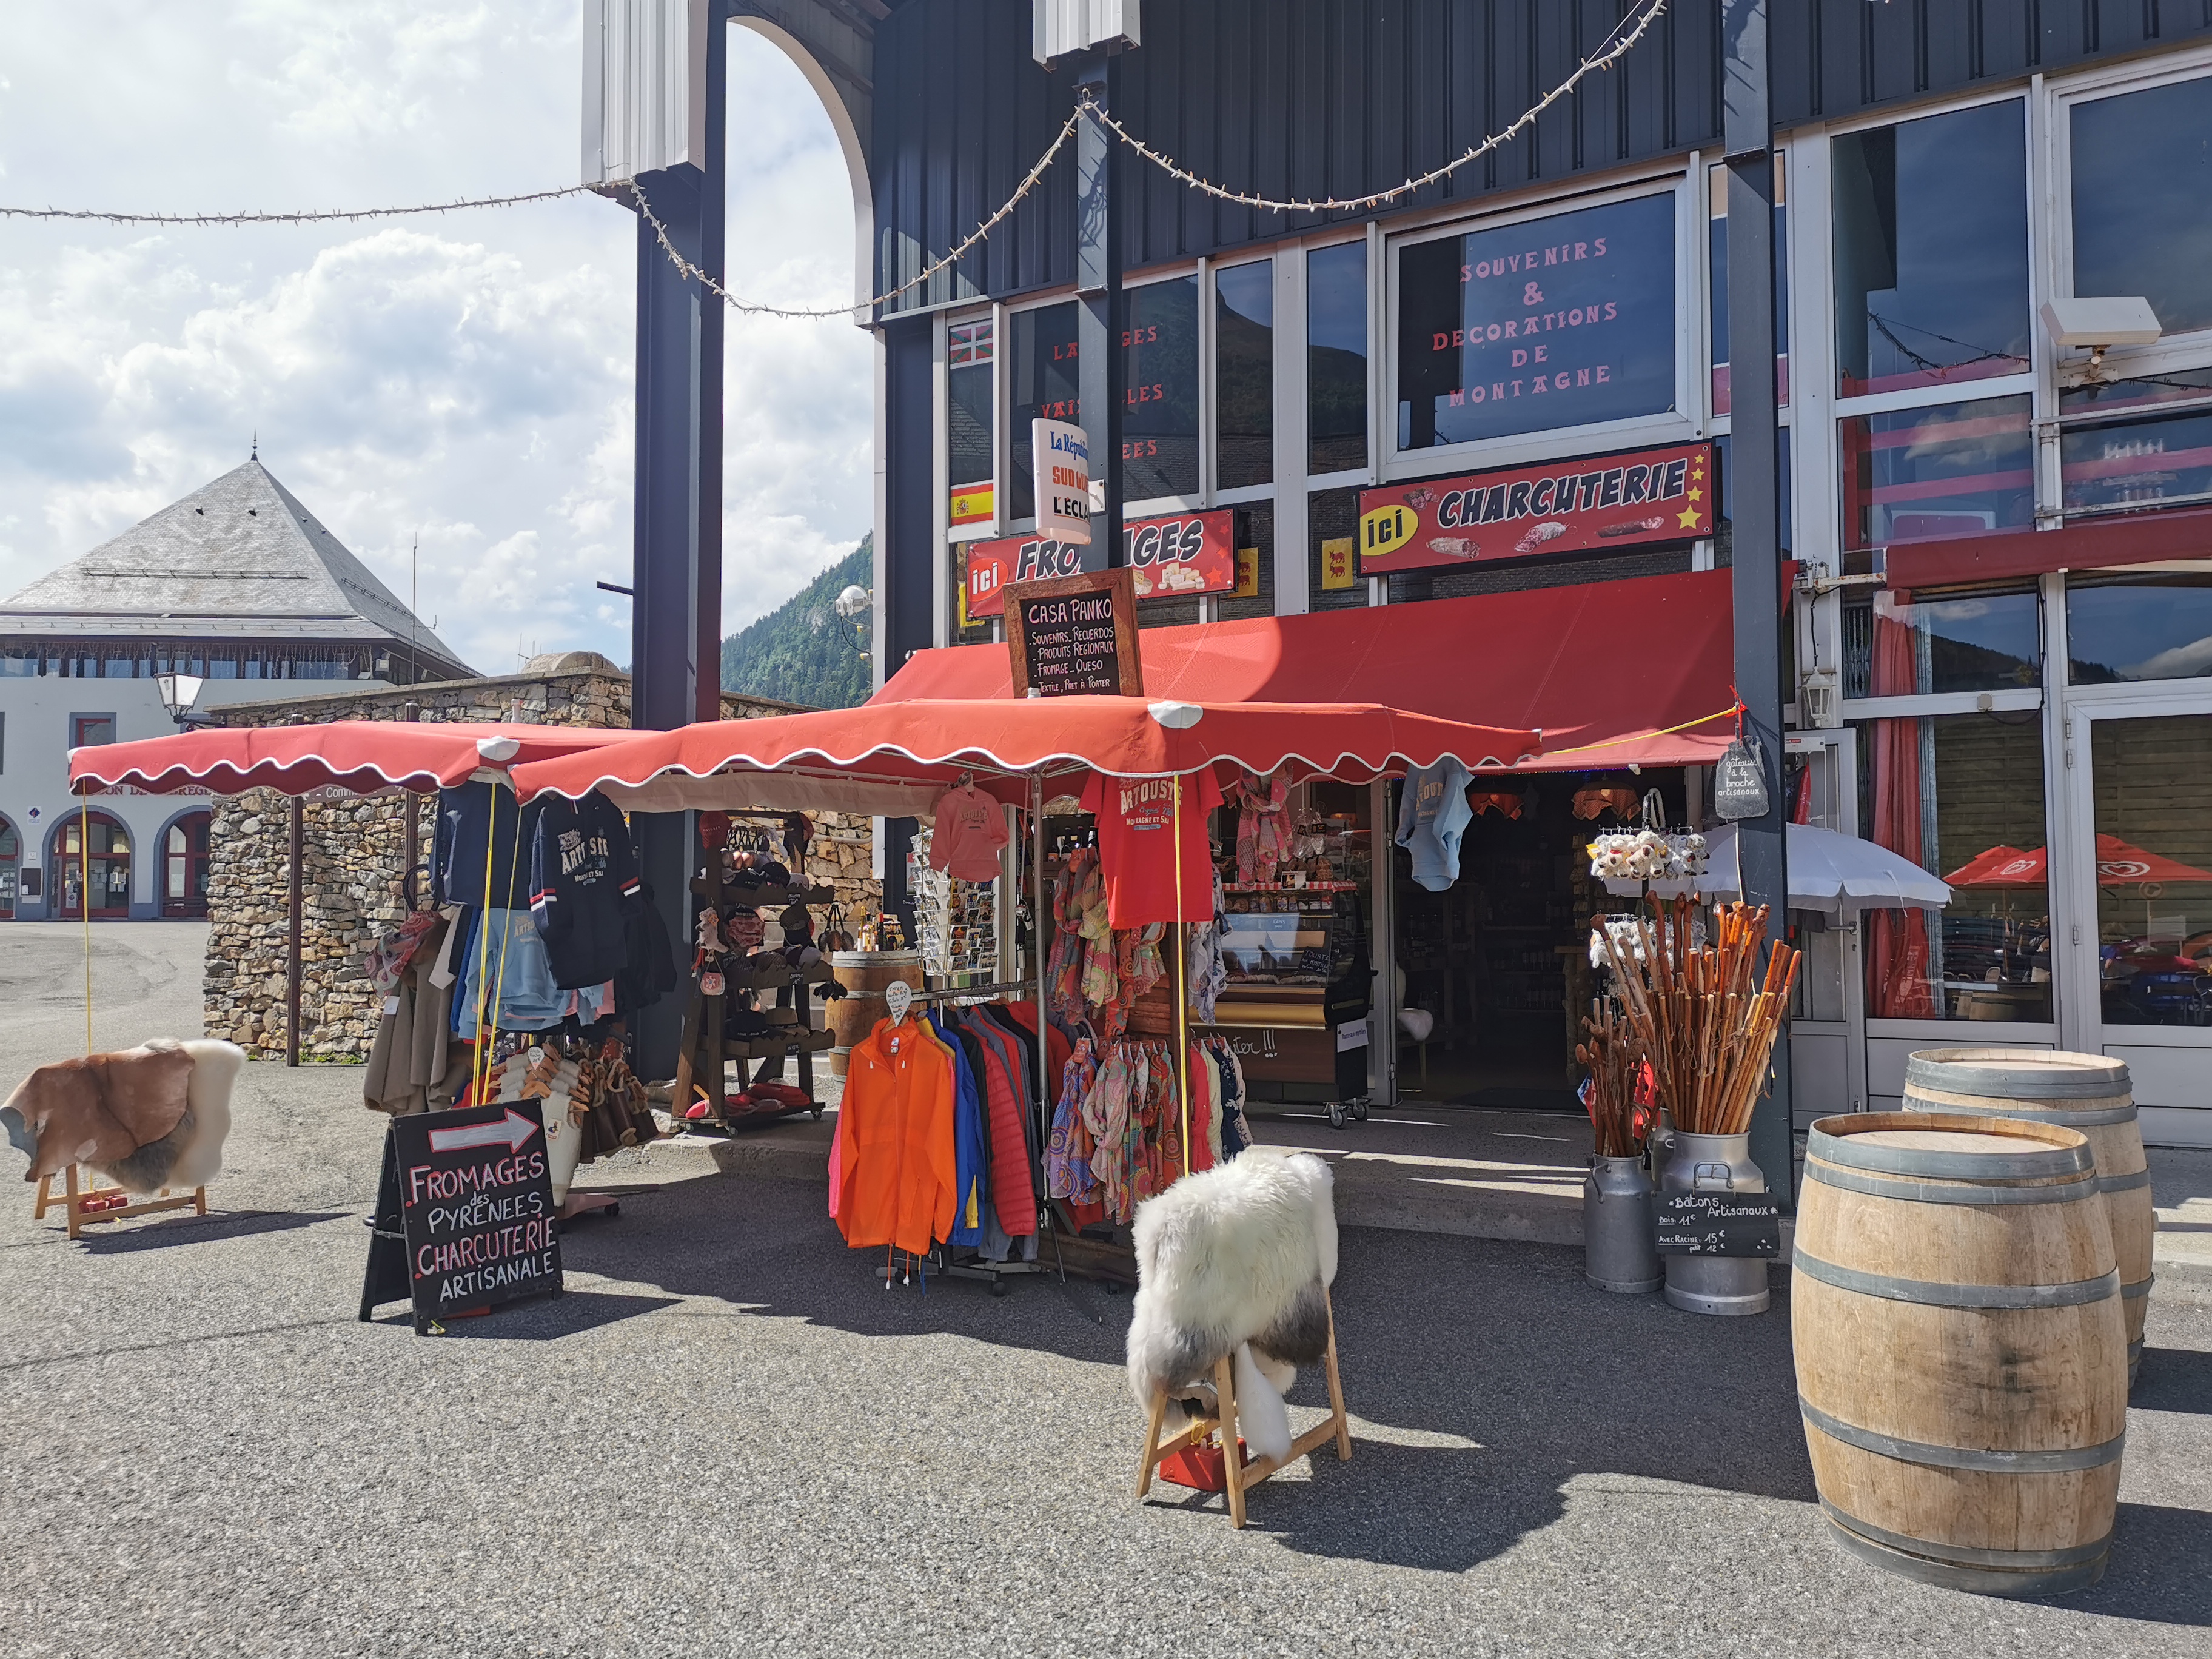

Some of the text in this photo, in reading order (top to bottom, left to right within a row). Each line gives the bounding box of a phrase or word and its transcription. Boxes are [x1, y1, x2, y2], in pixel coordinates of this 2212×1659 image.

[1460, 237, 1607, 283] SOUVENIRS
[1523, 281, 1545, 306] &
[1432, 301, 1617, 351] DECORATIONS
[1511, 344, 1548, 368] DE
[1449, 365, 1610, 407] MONTAGNE
[1050, 431, 1062, 451] La
[1052, 466, 1074, 488] SUD
[1367, 457, 1687, 548] ici CHARCUTERIE
[972, 518, 1204, 595] ici FROGES
[1029, 598, 1113, 623] CASA PANKO
[1072, 626, 1114, 640] RECUERDOS
[1037, 659, 1103, 677] FROMAGE QUESO
[1065, 678, 1078, 690] PRET
[1087, 675, 1110, 688] PORTER
[1726, 777, 1756, 787] broche
[1740, 768, 1749, 776] la
[409, 1151, 545, 1205] FROMAGES
[469, 1191, 490, 1207] des
[1675, 1193, 1719, 1208] Bâtons
[427, 1191, 543, 1234] PYRENEES
[1707, 1205, 1768, 1218] Artisanaux
[417, 1213, 557, 1276] CHARCUTERIE
[439, 1251, 554, 1303] ARTISANALE
